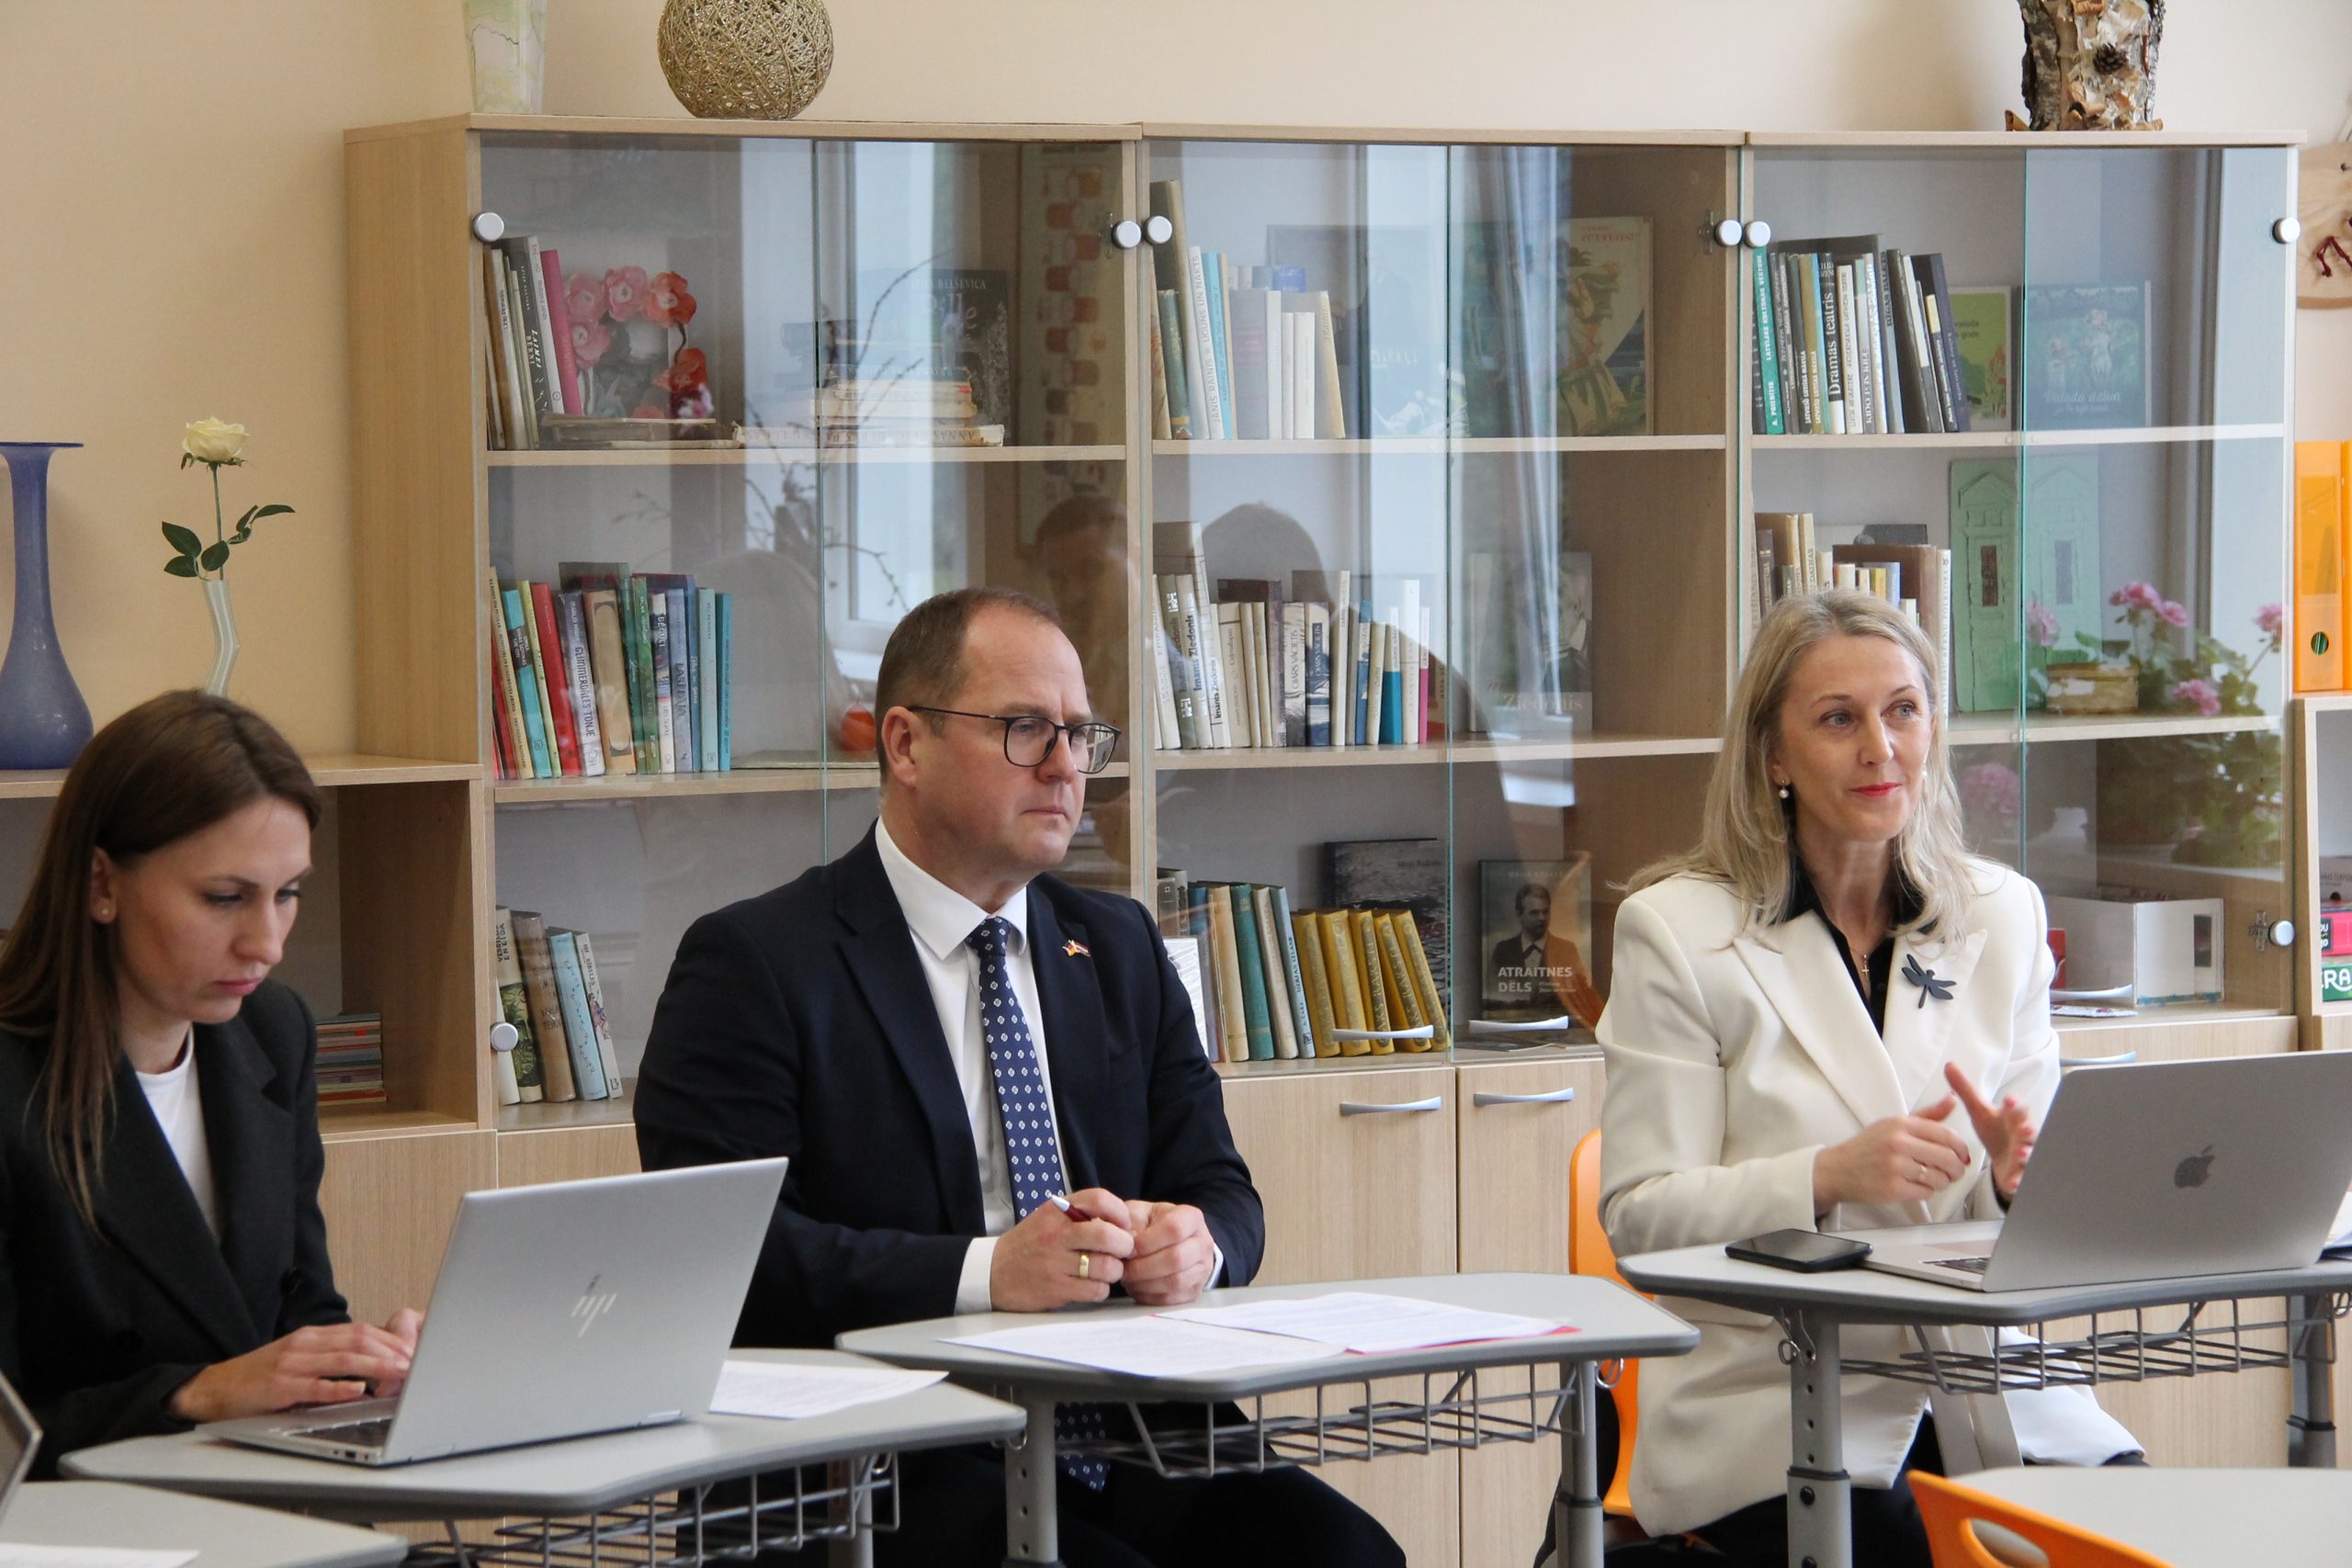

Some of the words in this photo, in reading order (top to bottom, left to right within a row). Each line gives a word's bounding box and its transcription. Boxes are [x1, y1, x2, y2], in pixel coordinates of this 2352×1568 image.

[1193, 255, 1202, 288] NAKTS
[1196, 290, 1205, 306] UN
[1824, 291, 1835, 336] teatris
[1200, 309, 1209, 343] UGUNS
[1764, 325, 1772, 360] LATVIJAS
[532, 330, 542, 368] LAIMES
[1206, 359, 1216, 391] RAINIS
[1827, 340, 1841, 396] Dramas
[1185, 615, 1198, 658] Ziedonis
[1191, 658, 1203, 691] Imants
[1209, 659, 1219, 692] Ziedonis
[1212, 692, 1222, 718] Imants
[583, 711, 594, 737] TONJE
[500, 922, 510, 961] ENEIDA
[1367, 941, 1382, 996] RAKSTI
[1391, 944, 1411, 998] RAKSTI
[1498, 966, 1573, 977] ATRAITNES
[1498, 979, 1532, 992] DĒLS
[1374, 1002, 1387, 1031] AKS
